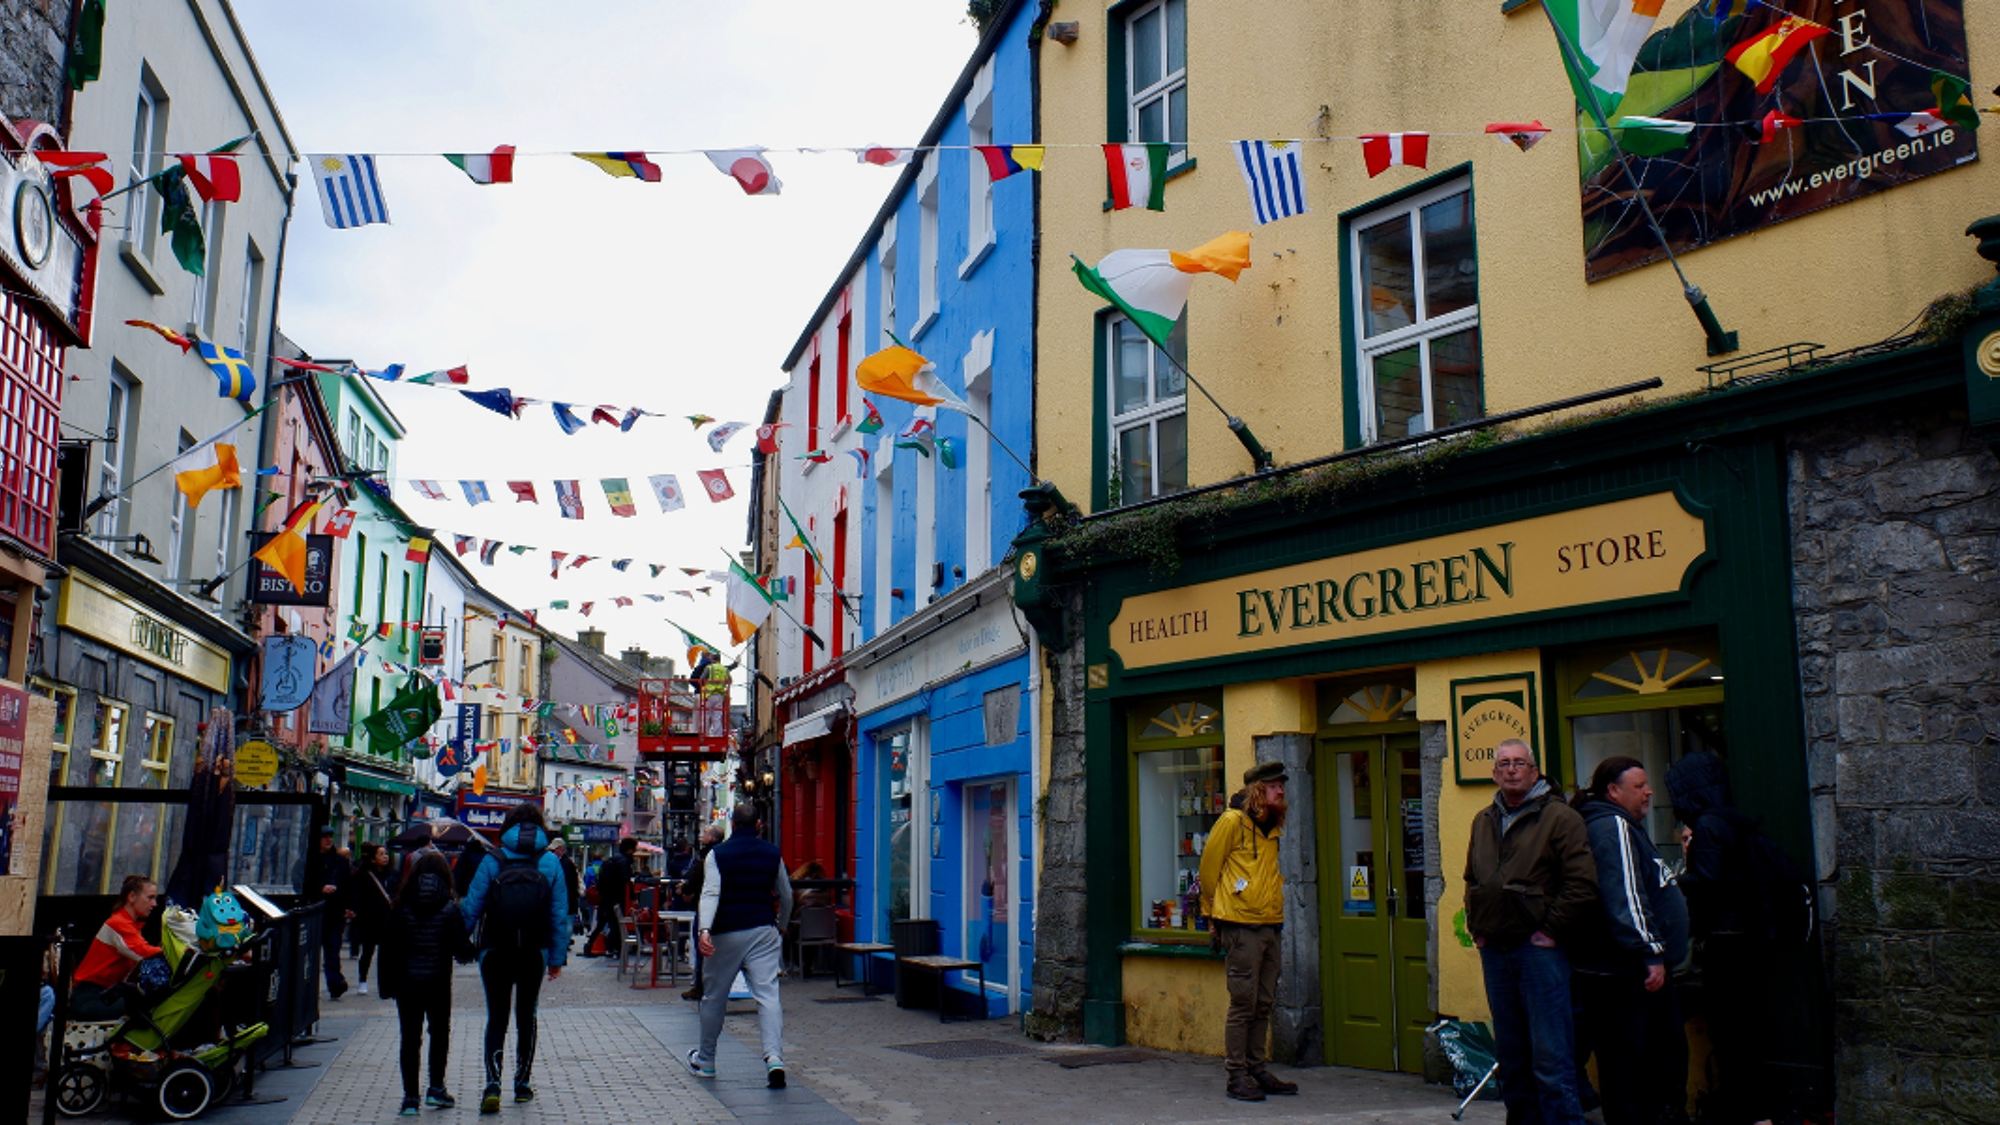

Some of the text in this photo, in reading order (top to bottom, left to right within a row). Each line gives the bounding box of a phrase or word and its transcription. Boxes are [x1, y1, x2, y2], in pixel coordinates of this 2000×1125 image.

[1834, 0, 1877, 111] EN
[1749, 128, 1955, 207] www.evergreen.ie
[1129, 529, 1666, 643] HEALTH EVERGREEN STORE
[1463, 710, 1527, 740] EVERGREEN
[1465, 748, 1495, 762] COR
